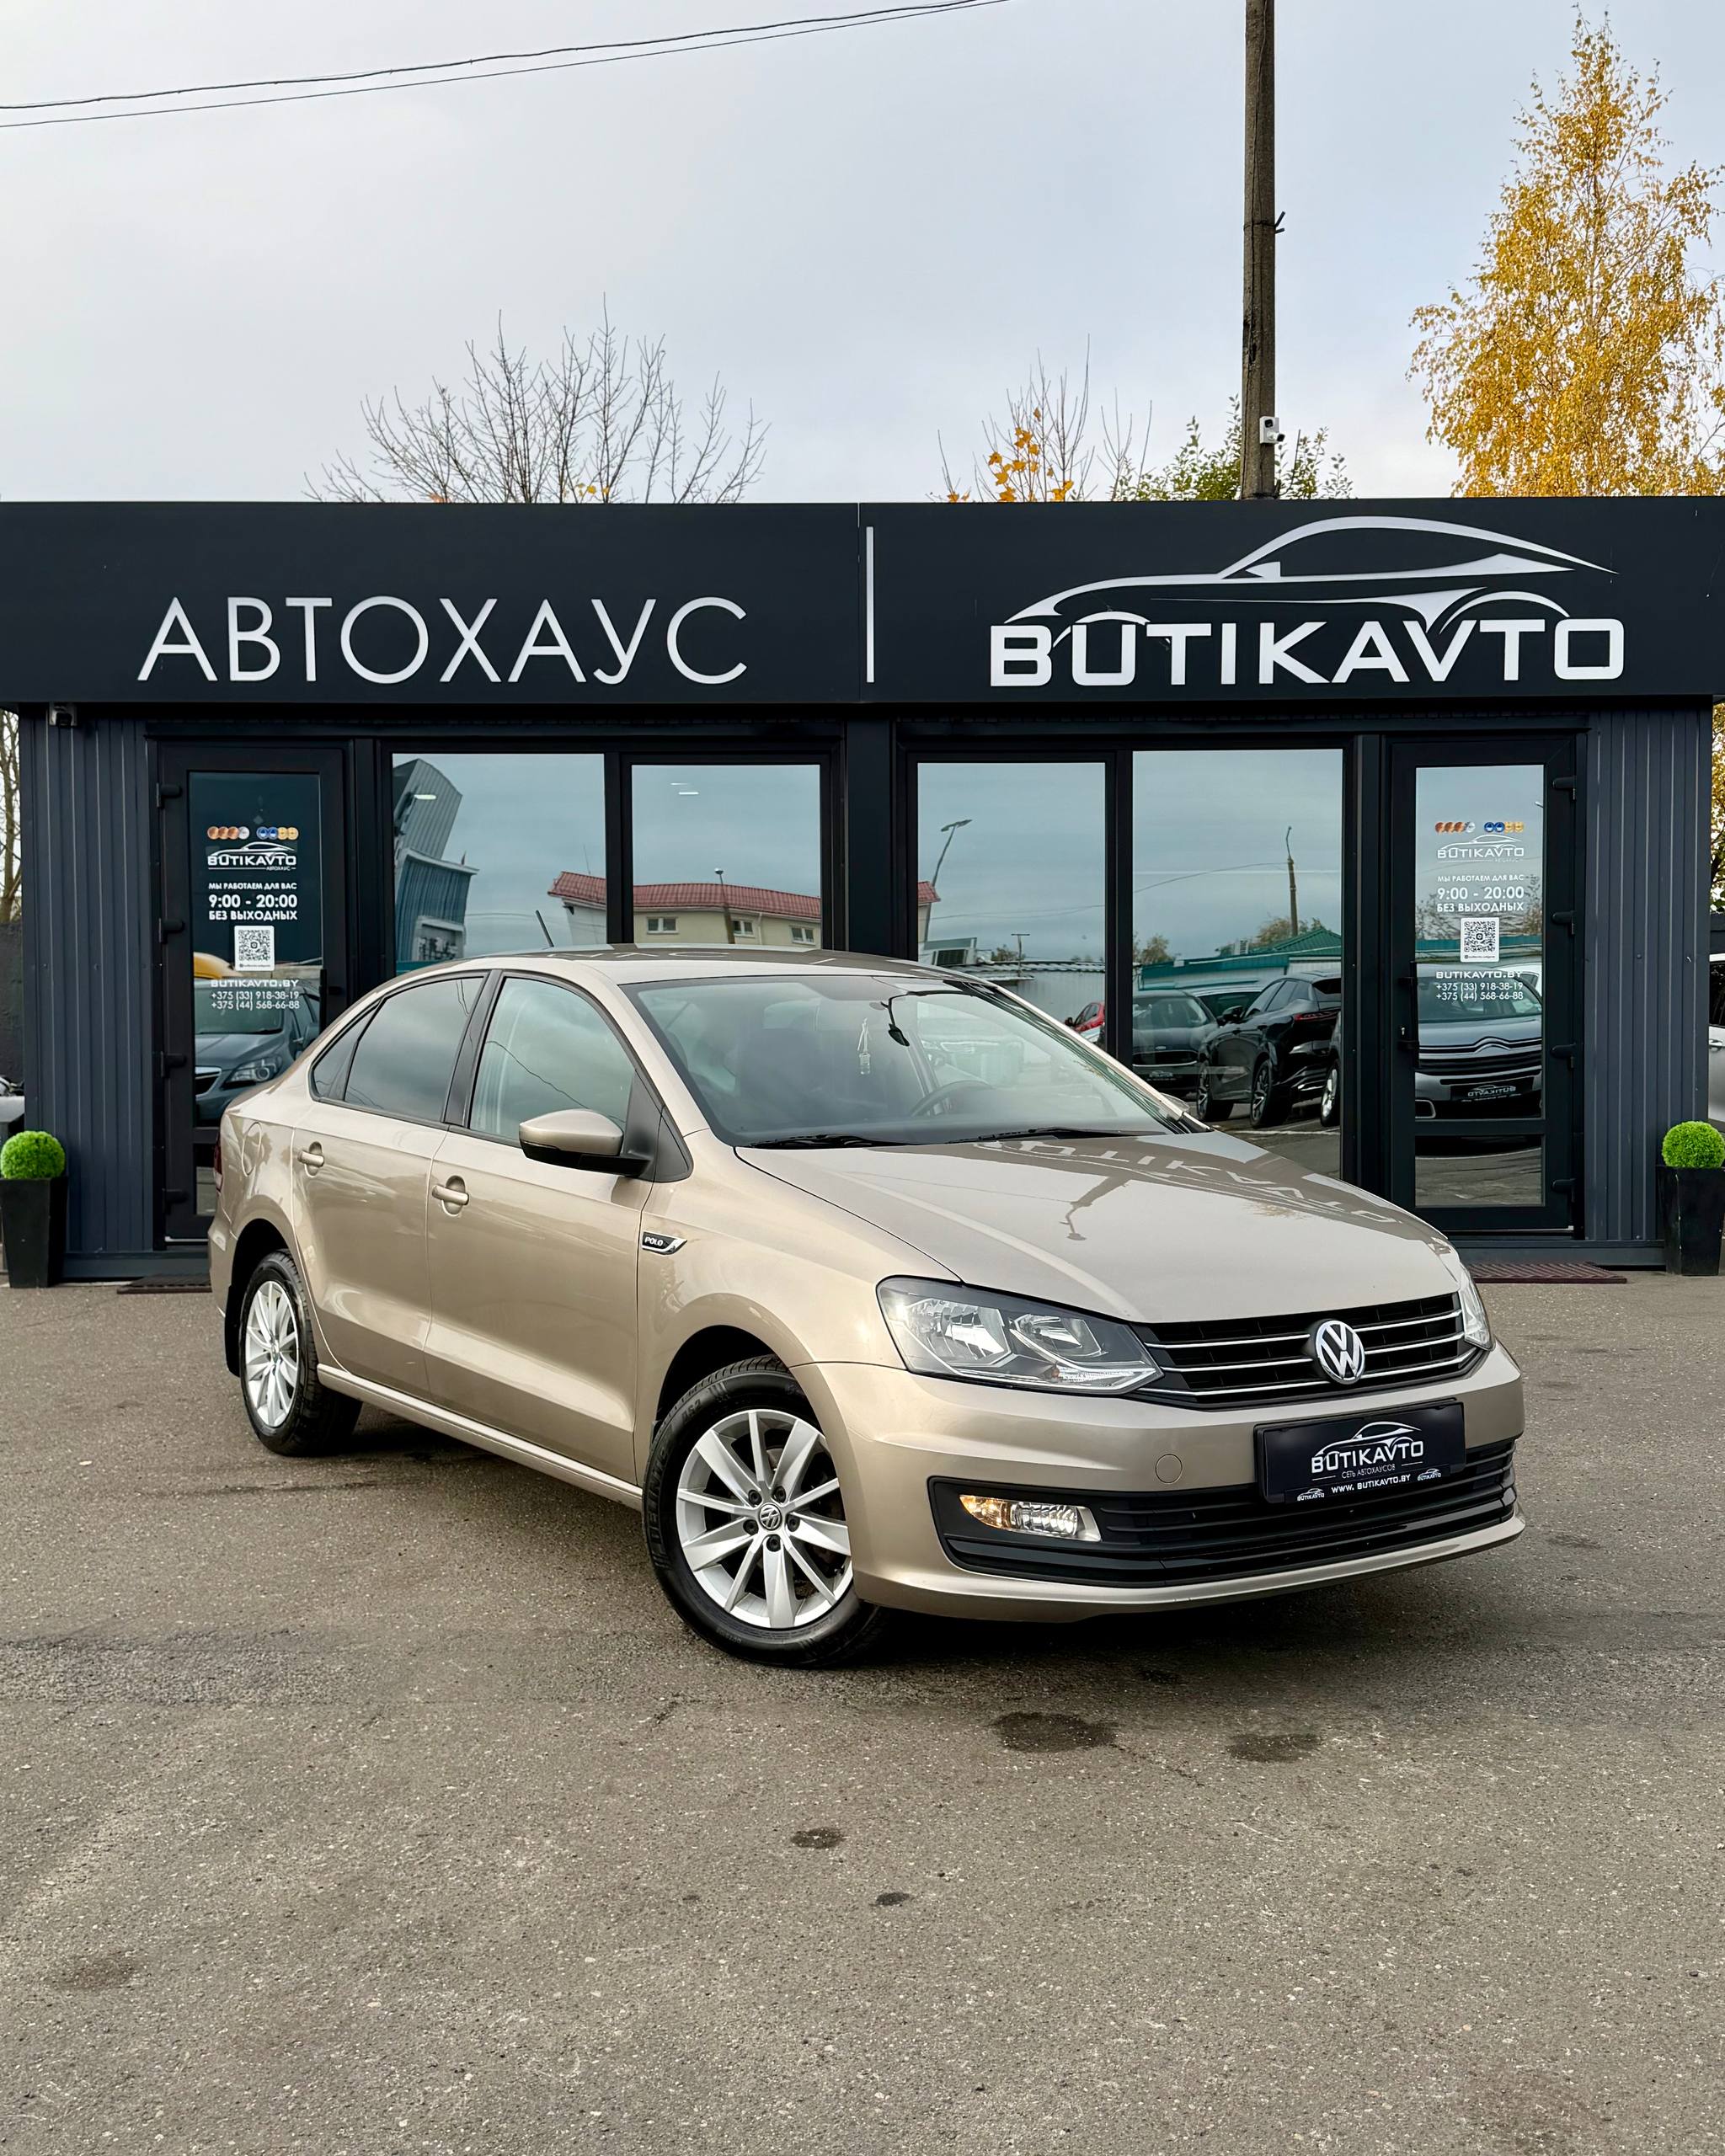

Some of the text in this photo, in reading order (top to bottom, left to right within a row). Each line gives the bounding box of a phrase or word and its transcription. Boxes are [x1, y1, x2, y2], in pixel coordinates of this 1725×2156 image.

[137, 595, 747, 685] АВТОХАУС
[990, 616, 1624, 687] BUTIKAVTO
[1437, 847, 1525, 858] BUTIKAVTO
[207, 855, 296, 866] BUTIKAVTO
[1437, 888, 1468, 899] 9:00
[1483, 886, 1525, 899] 20:00
[208, 894, 241, 908] 9:00
[256, 894, 297, 908] 20:00
[1437, 902, 1524, 912] БЕЗ ВЫХОДНЫХ
[209, 910, 297, 921] БЕЗ ВЫХОДНЫХ
[1436, 982, 1524, 992] +375 (33) 918-38-19
[211, 991, 299, 1001] +375 (33) 918-38-19
[1436, 991, 1524, 1001] +375 (44) 568-66-88
[211, 1001, 300, 1011] +375 (44) 568-66-88
[644, 1236, 664, 1246] POLO
[1311, 1441, 1424, 1473] BUTIKAVTO
[1341, 1464, 1396, 1479] СЕТЬ АВТОХАУСОВ
[1332, 1474, 1411, 1493] WWW. BUTIKAVTO.BY
